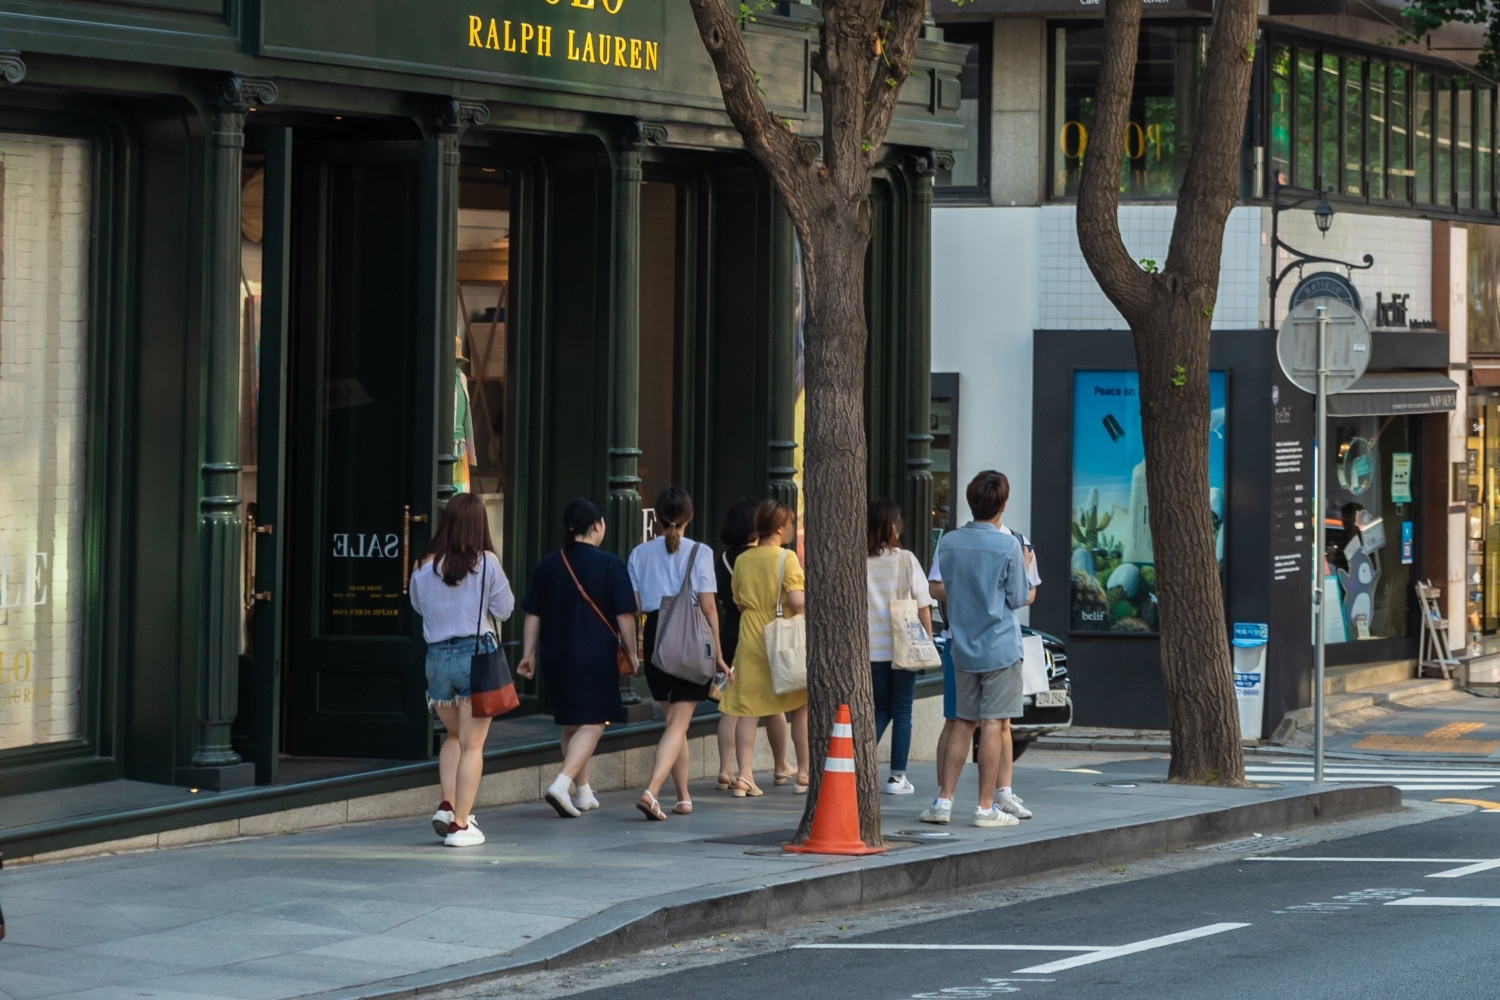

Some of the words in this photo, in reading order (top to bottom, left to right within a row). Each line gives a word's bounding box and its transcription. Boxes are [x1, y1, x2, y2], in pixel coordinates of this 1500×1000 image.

[468, 15, 552, 57] RALPH
[567, 29, 659, 71] LAUREN
[1094, 386, 1121, 396] Peace
[1082, 611, 1105, 621] belif
